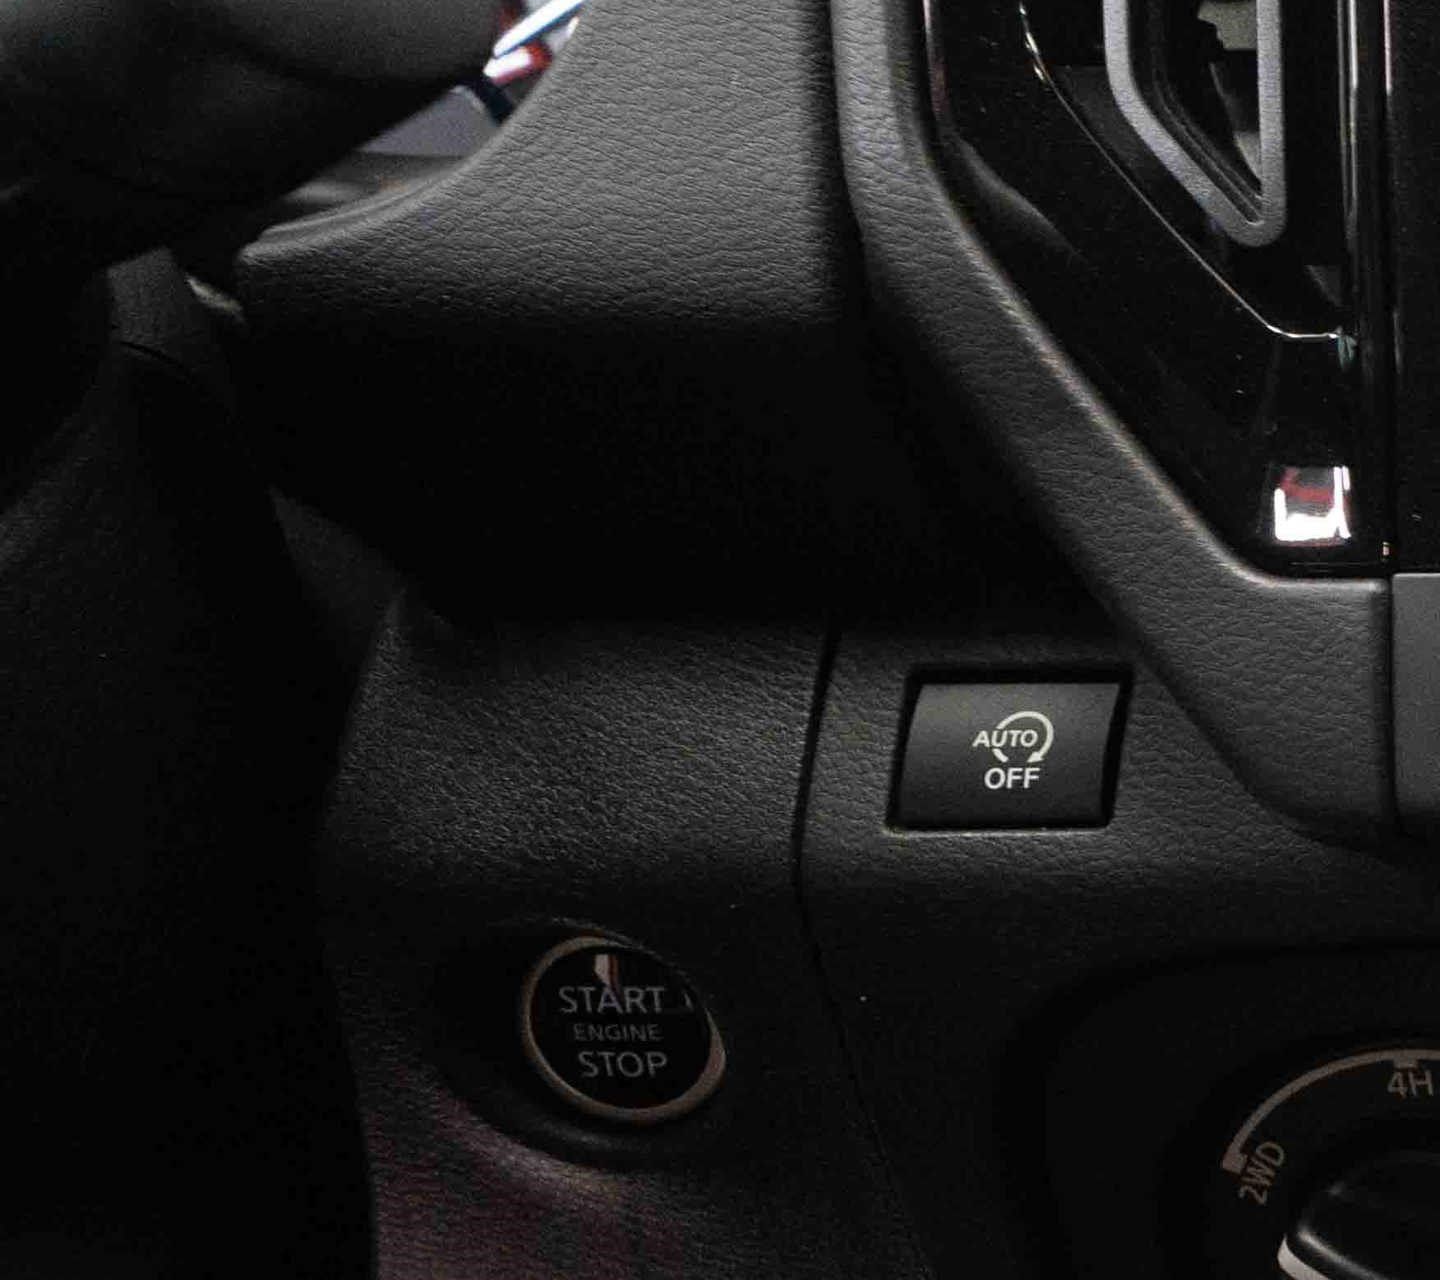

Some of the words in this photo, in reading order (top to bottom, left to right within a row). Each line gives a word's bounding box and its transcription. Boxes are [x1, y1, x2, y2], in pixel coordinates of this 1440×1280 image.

[972, 729, 1038, 748] AUTO
[984, 767, 1041, 790] OFF
[558, 986, 666, 1015] START
[573, 1022, 664, 1042] ENGINE
[577, 1050, 668, 1079] STOP
[1387, 1069, 1434, 1098] 4H
[1239, 1140, 1286, 1206] 2WD
